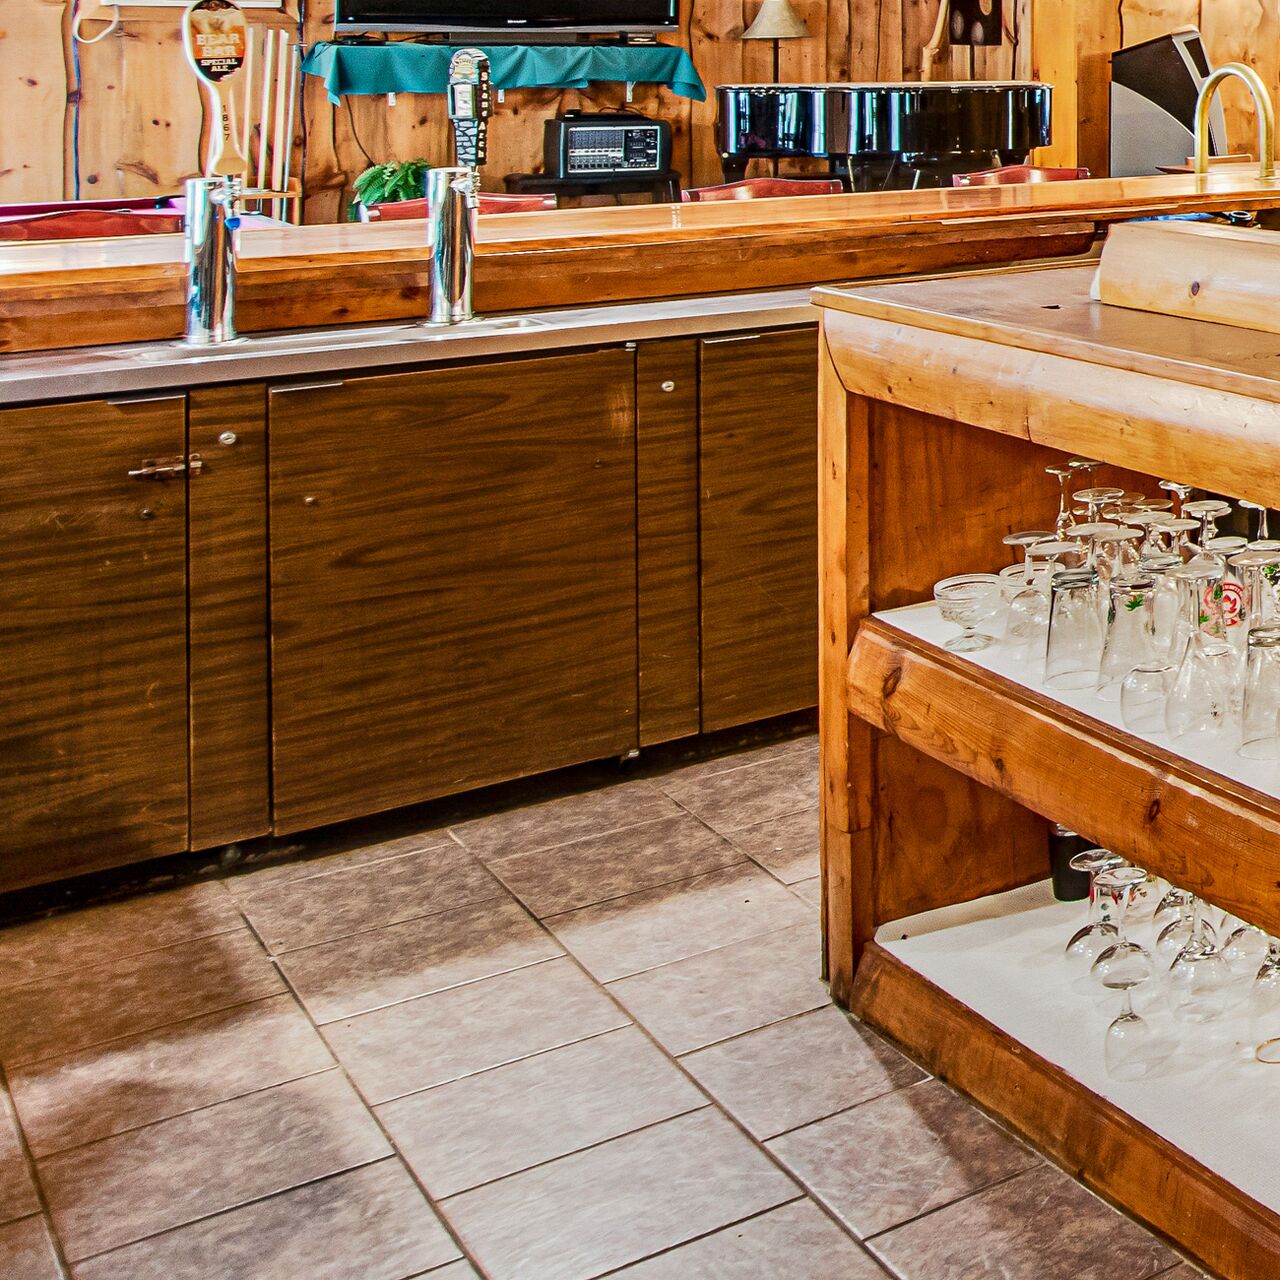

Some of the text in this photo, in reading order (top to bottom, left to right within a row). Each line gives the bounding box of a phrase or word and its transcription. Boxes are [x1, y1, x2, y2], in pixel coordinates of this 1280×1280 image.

[196, 33, 241, 46] BEAR
[202, 45, 237, 57] BAR
[201, 58, 238, 66] SPECIAL
[477, 71, 489, 158] Stone Arch
[222, 104, 230, 141] 1867
